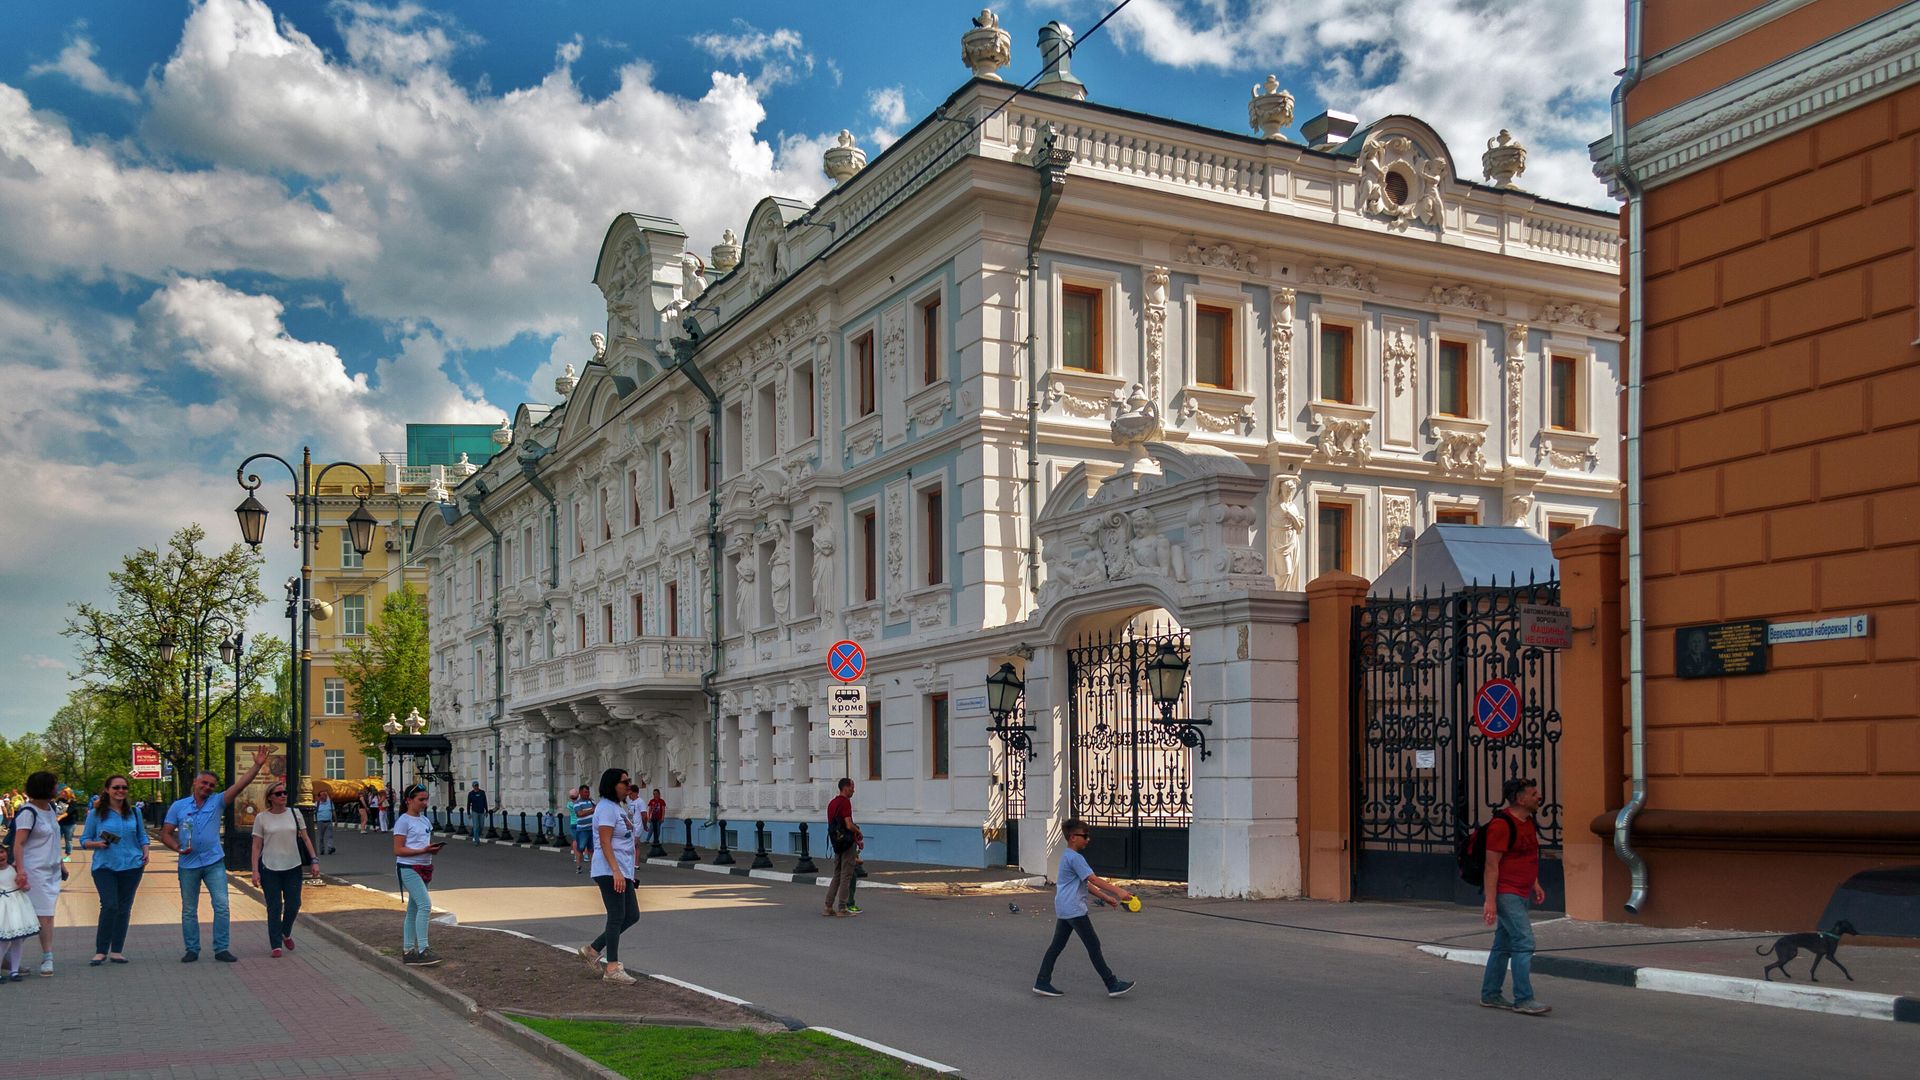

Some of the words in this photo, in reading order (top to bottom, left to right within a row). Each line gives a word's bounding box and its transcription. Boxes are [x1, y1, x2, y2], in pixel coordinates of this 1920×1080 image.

[1815, 623, 1848, 638] набережная
[1856, 619, 1863, 632] 6
[832, 704, 864, 713] кроме
